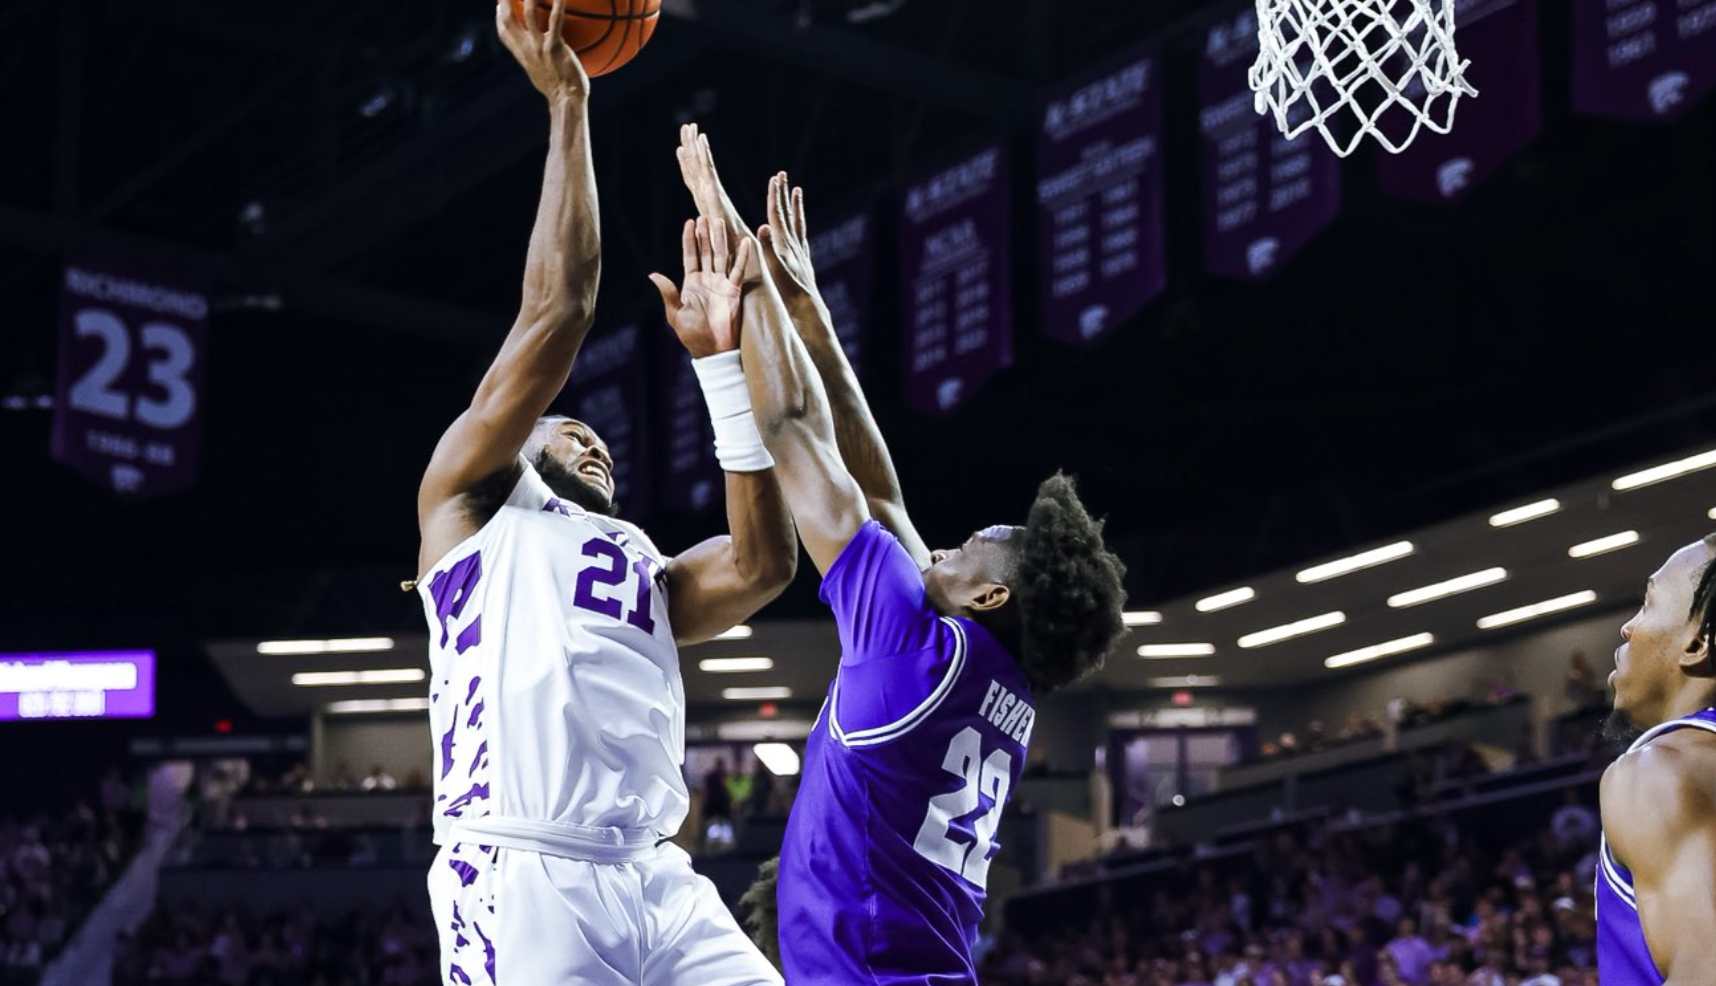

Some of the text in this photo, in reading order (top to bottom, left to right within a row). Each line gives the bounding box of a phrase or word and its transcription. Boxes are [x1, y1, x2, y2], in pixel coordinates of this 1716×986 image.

[66, 266, 208, 321] RICHMOND
[69, 307, 197, 430] 23
[573, 537, 655, 635] 21
[913, 726, 1011, 889] 22
